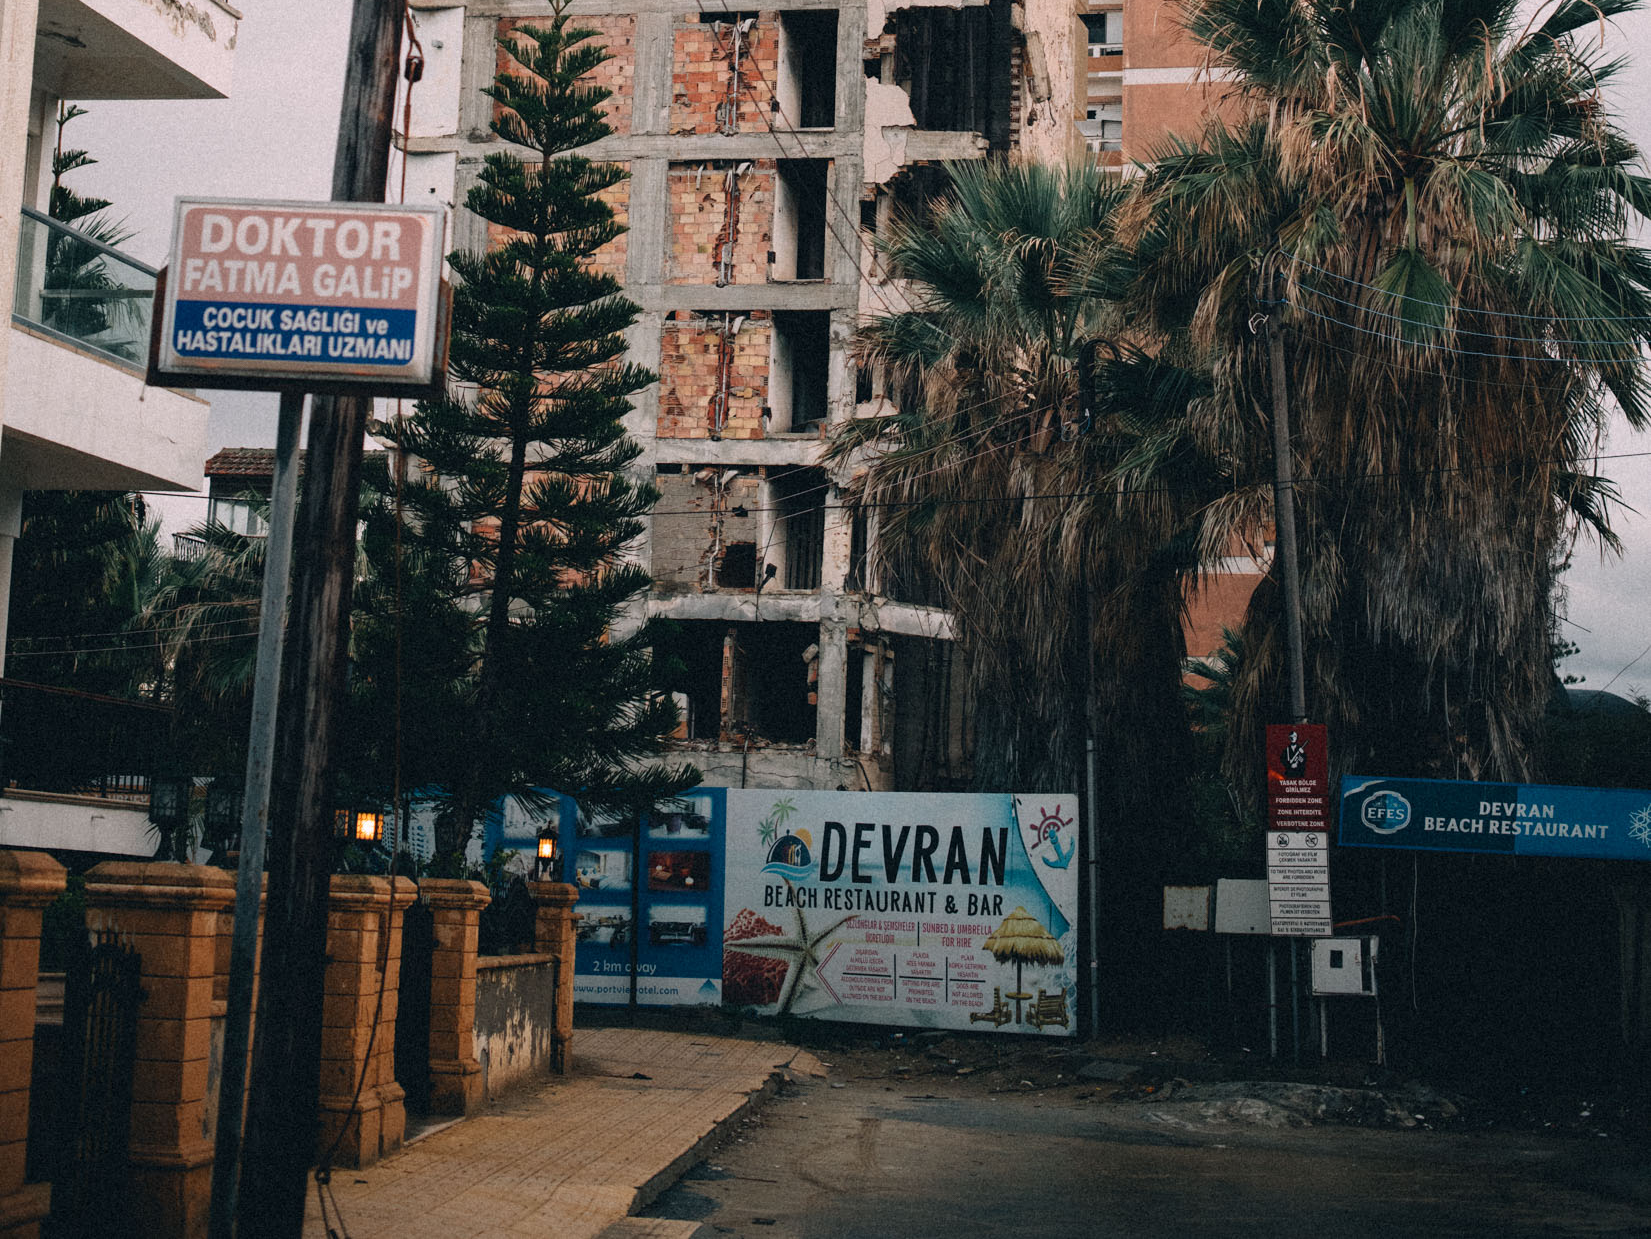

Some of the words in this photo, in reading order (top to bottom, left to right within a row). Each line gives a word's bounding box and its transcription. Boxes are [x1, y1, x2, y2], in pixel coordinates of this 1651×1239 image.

[200, 214, 402, 260] DOKTOR
[184, 258, 302, 295] FATMA
[203, 307, 275, 330] ÇOCUK
[280, 308, 360, 333] SAĞLIĞI
[366, 319, 388, 334] ve
[177, 330, 322, 355] HASTALIKLARI
[328, 337, 412, 360] UZMANI
[1367, 807, 1404, 820] EFES
[1479, 801, 1554, 818] DEVRAN
[1424, 817, 1483, 833] BEACH
[1488, 819, 1608, 839] RESTAURANT
[820, 821, 1008, 885] DEVRAN
[764, 885, 817, 909] BEACH
[824, 888, 937, 913] RESTAURANT
[945, 895, 958, 914] &
[968, 894, 1003, 916] BAR
[922, 922, 948, 934] SUNBED
[951, 924, 955, 934] &
[957, 924, 992, 935] UMBRELLA
[942, 937, 954, 947] FOR
[956, 937, 971, 948] HIRE
[593, 960, 600, 972] 2
[603, 959, 621, 972] km
[574, 985, 679, 995] www.portvieotel.com
